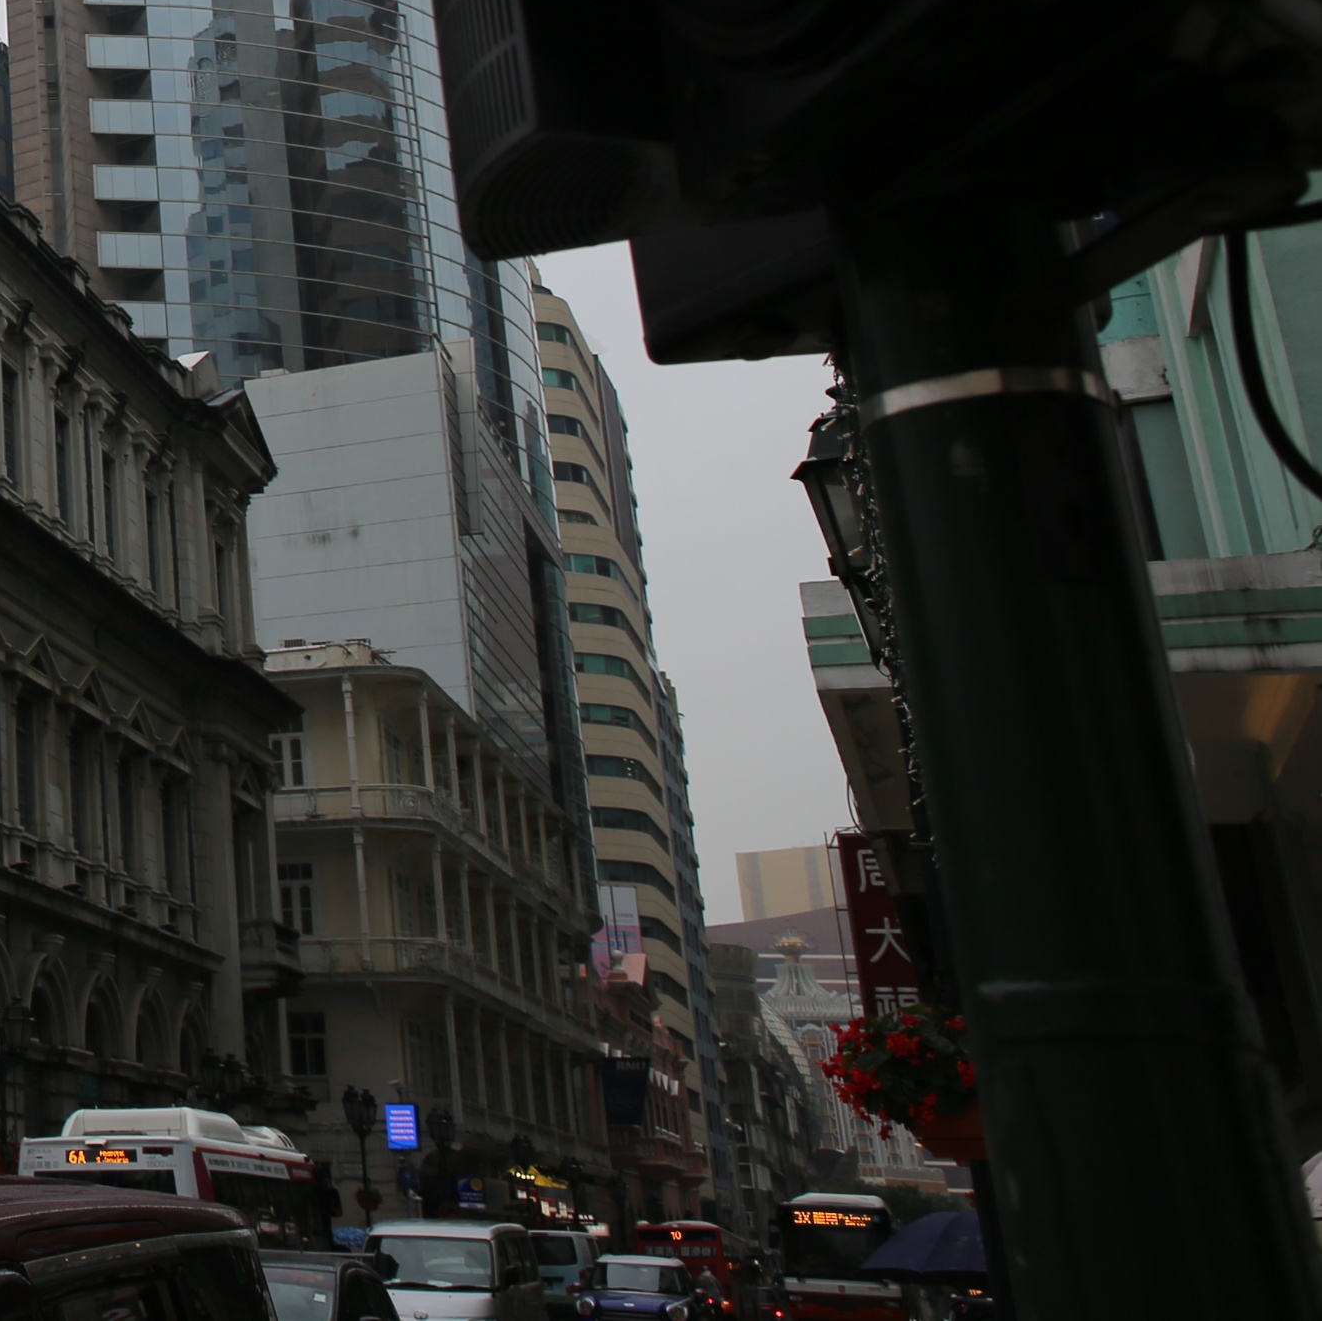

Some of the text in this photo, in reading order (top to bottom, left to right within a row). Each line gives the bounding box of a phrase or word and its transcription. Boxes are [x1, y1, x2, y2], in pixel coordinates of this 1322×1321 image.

[68, 1150, 87, 1164] 6A
[793, 1211, 811, 1225] 3X
[670, 1231, 682, 1241] 10
